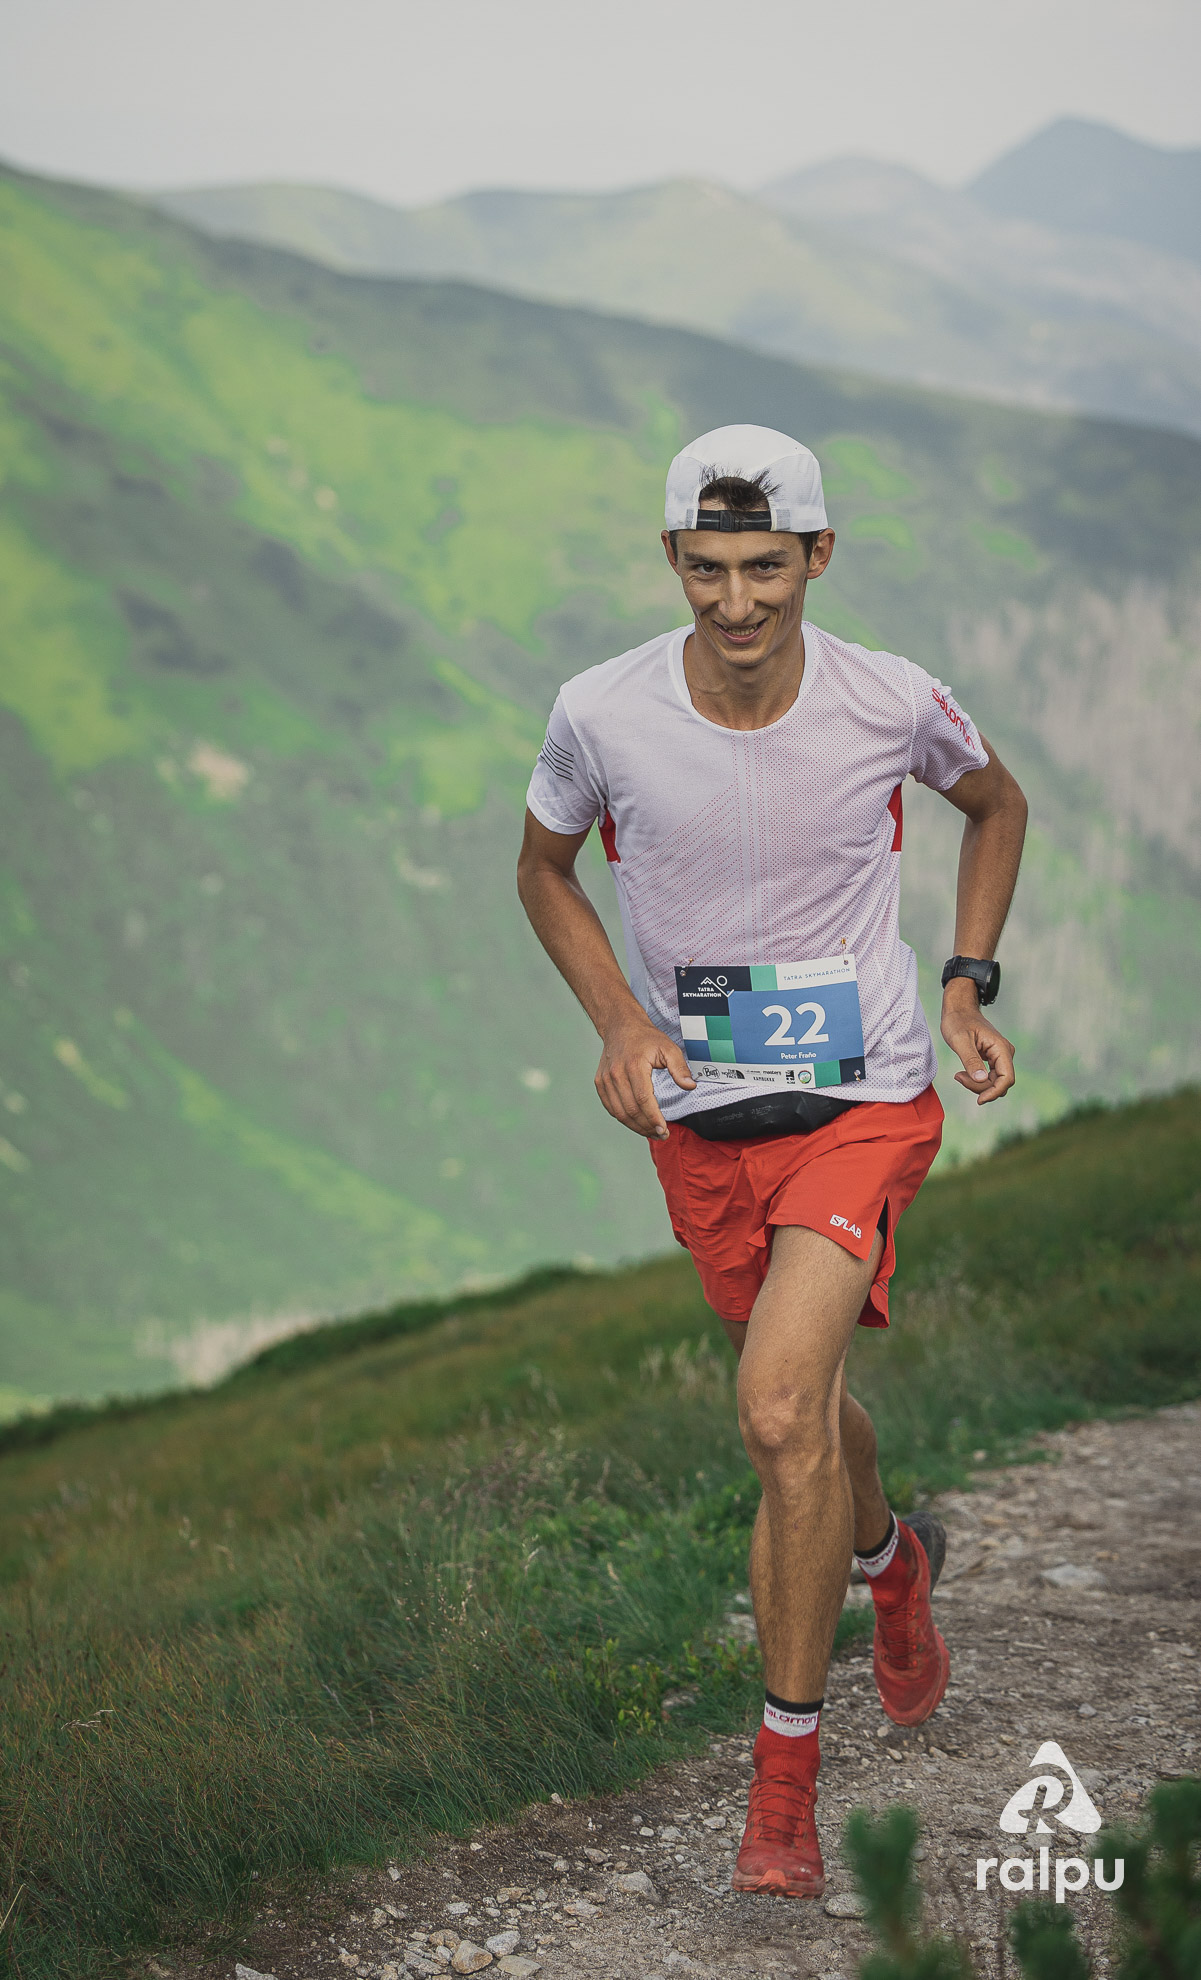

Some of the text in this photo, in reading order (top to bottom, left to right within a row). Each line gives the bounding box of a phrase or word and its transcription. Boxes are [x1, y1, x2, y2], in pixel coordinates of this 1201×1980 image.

[804, 967, 851, 979] SKYMARATHON
[762, 1002, 829, 1046] 22
[780, 1052, 797, 1060] Peter
